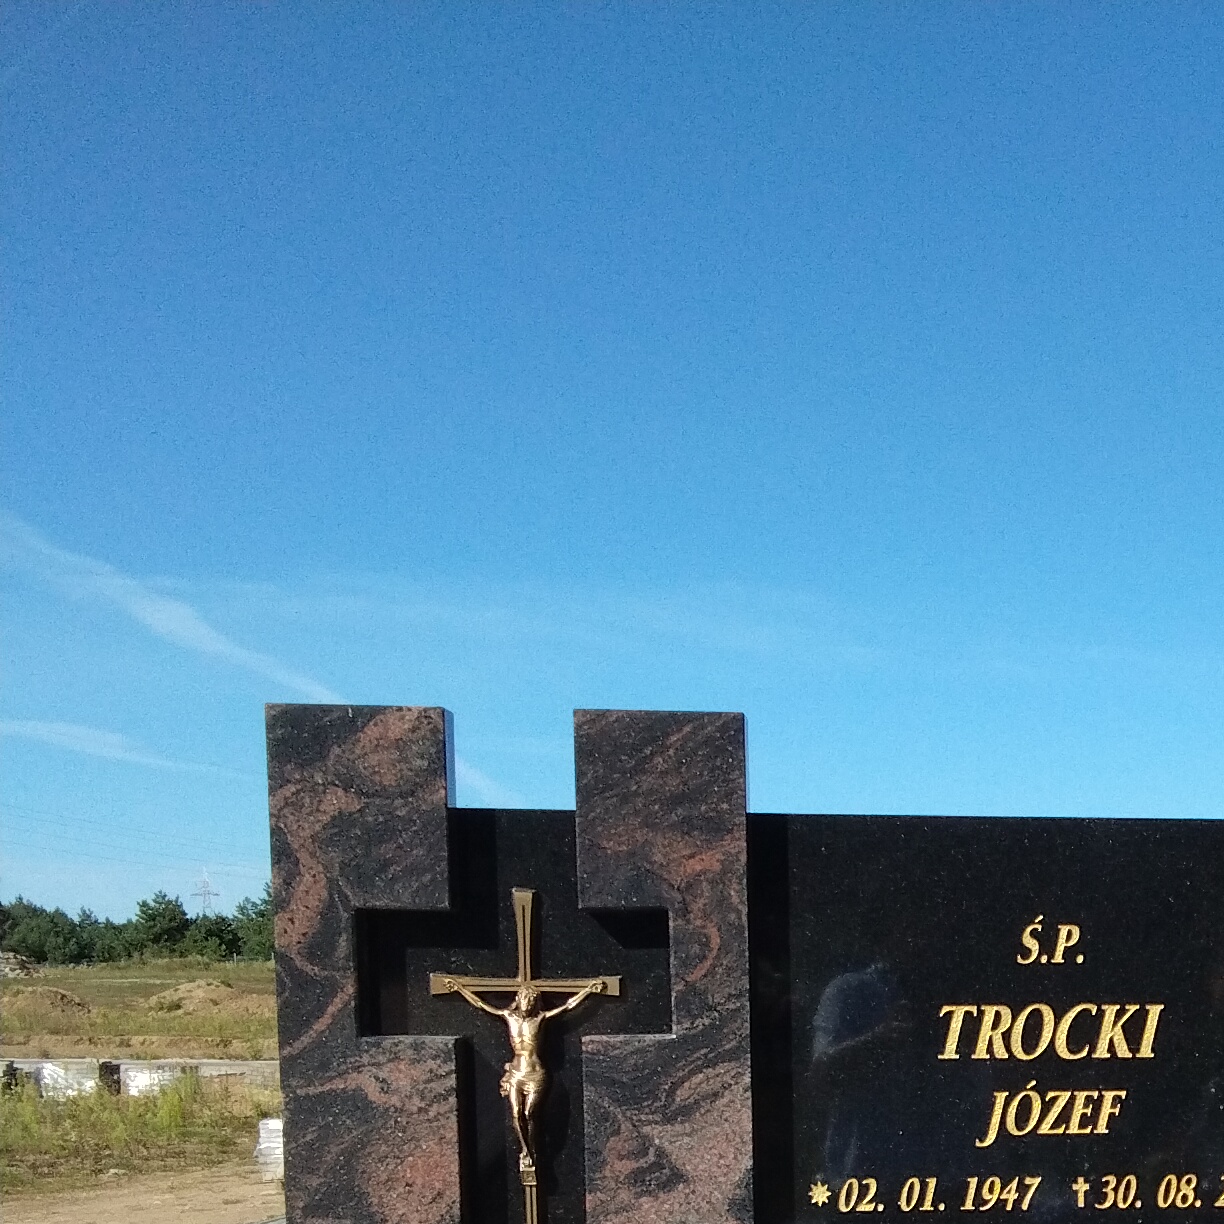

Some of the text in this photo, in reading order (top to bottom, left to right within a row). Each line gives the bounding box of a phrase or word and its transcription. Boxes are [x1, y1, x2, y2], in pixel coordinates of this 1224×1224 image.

[1017, 915, 1084, 964] Ś.P.
[938, 1003, 1164, 1060] TROCKI
[975, 1080, 1127, 1147] JÓZEF
[899, 1176, 946, 1212] 01.
[960, 1176, 1042, 1211] 1947
[1157, 1173, 1202, 1209] 08.
